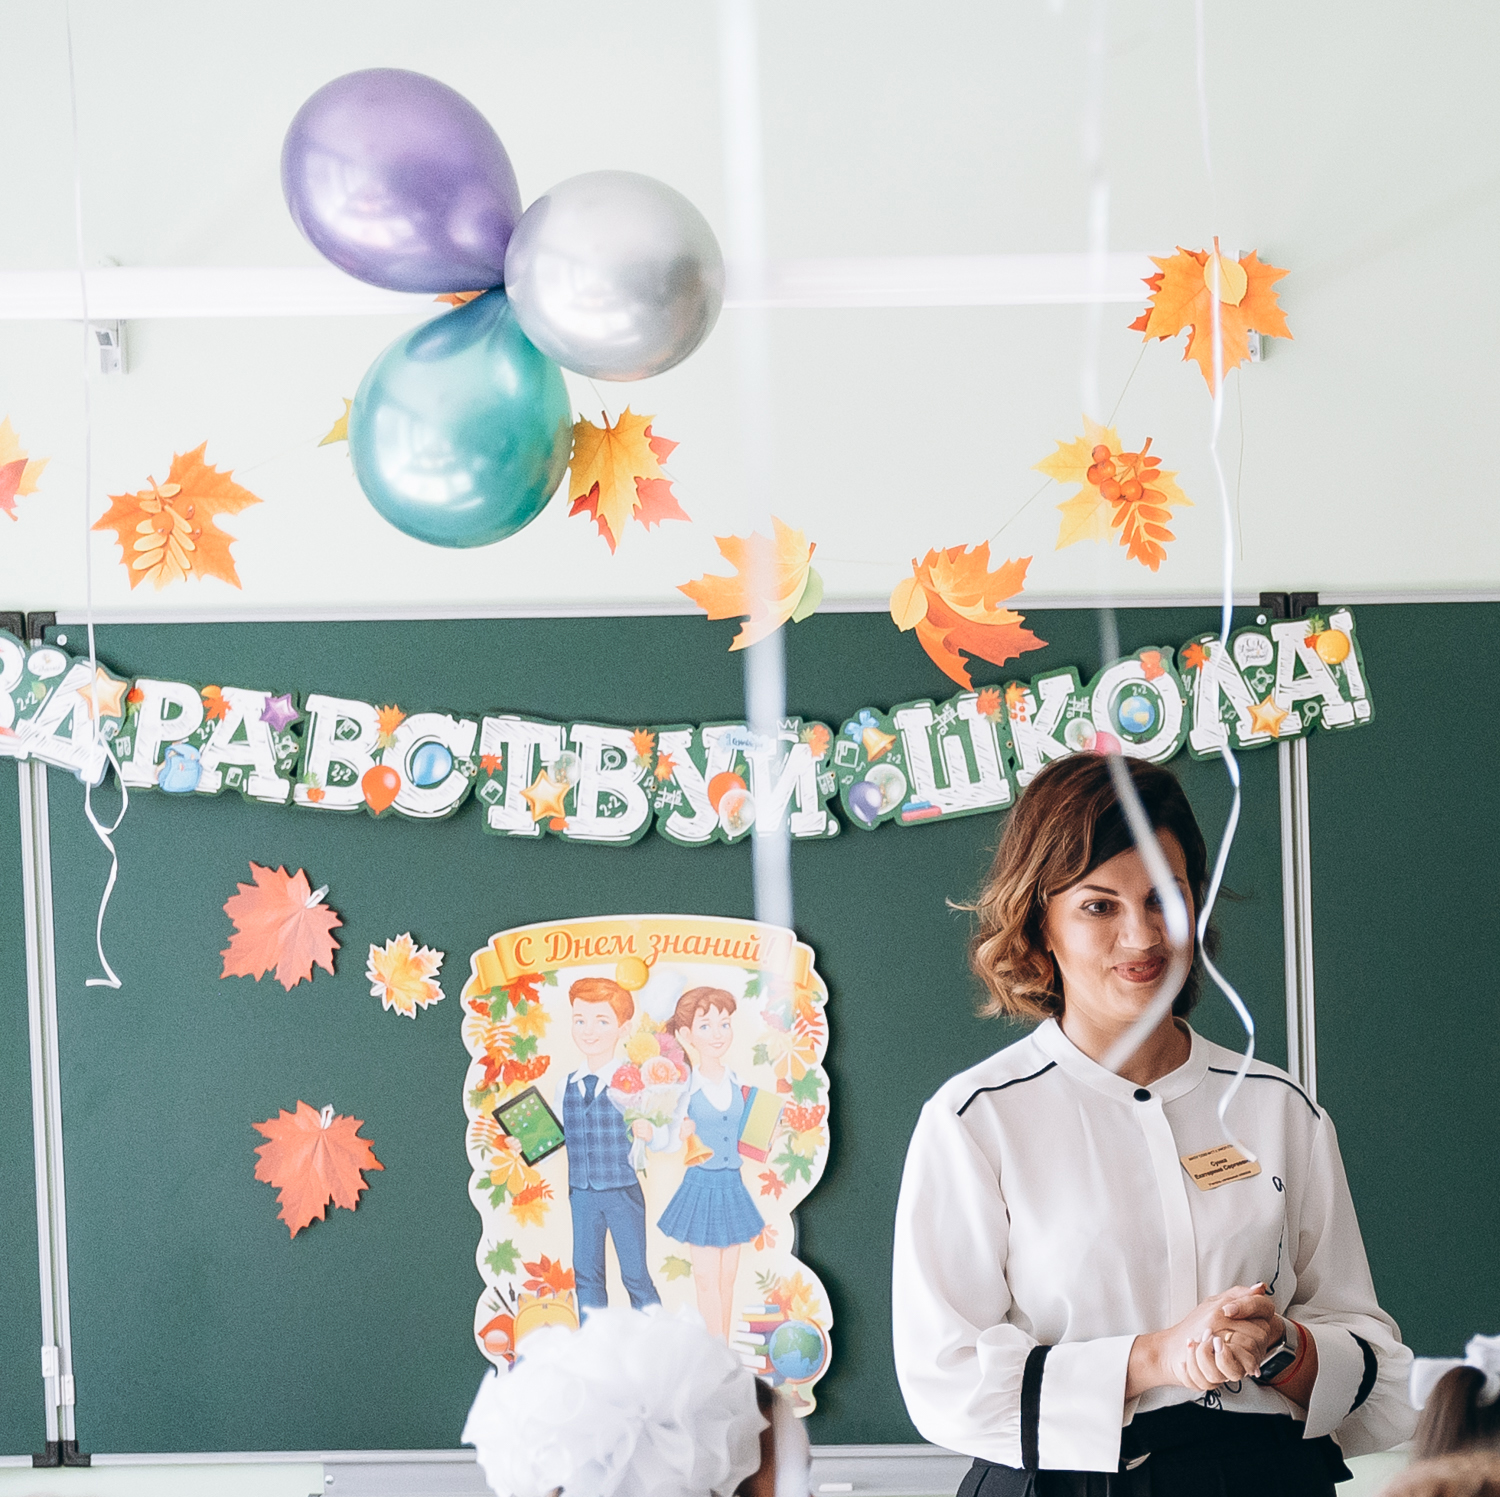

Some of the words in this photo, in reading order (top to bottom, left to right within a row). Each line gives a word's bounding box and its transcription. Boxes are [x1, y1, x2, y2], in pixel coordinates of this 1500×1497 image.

[0, 637, 828, 842] ДРАВСТВУЙ
[895, 609, 1371, 814] ШКОЛА!
[544, 931, 637, 963] Днем
